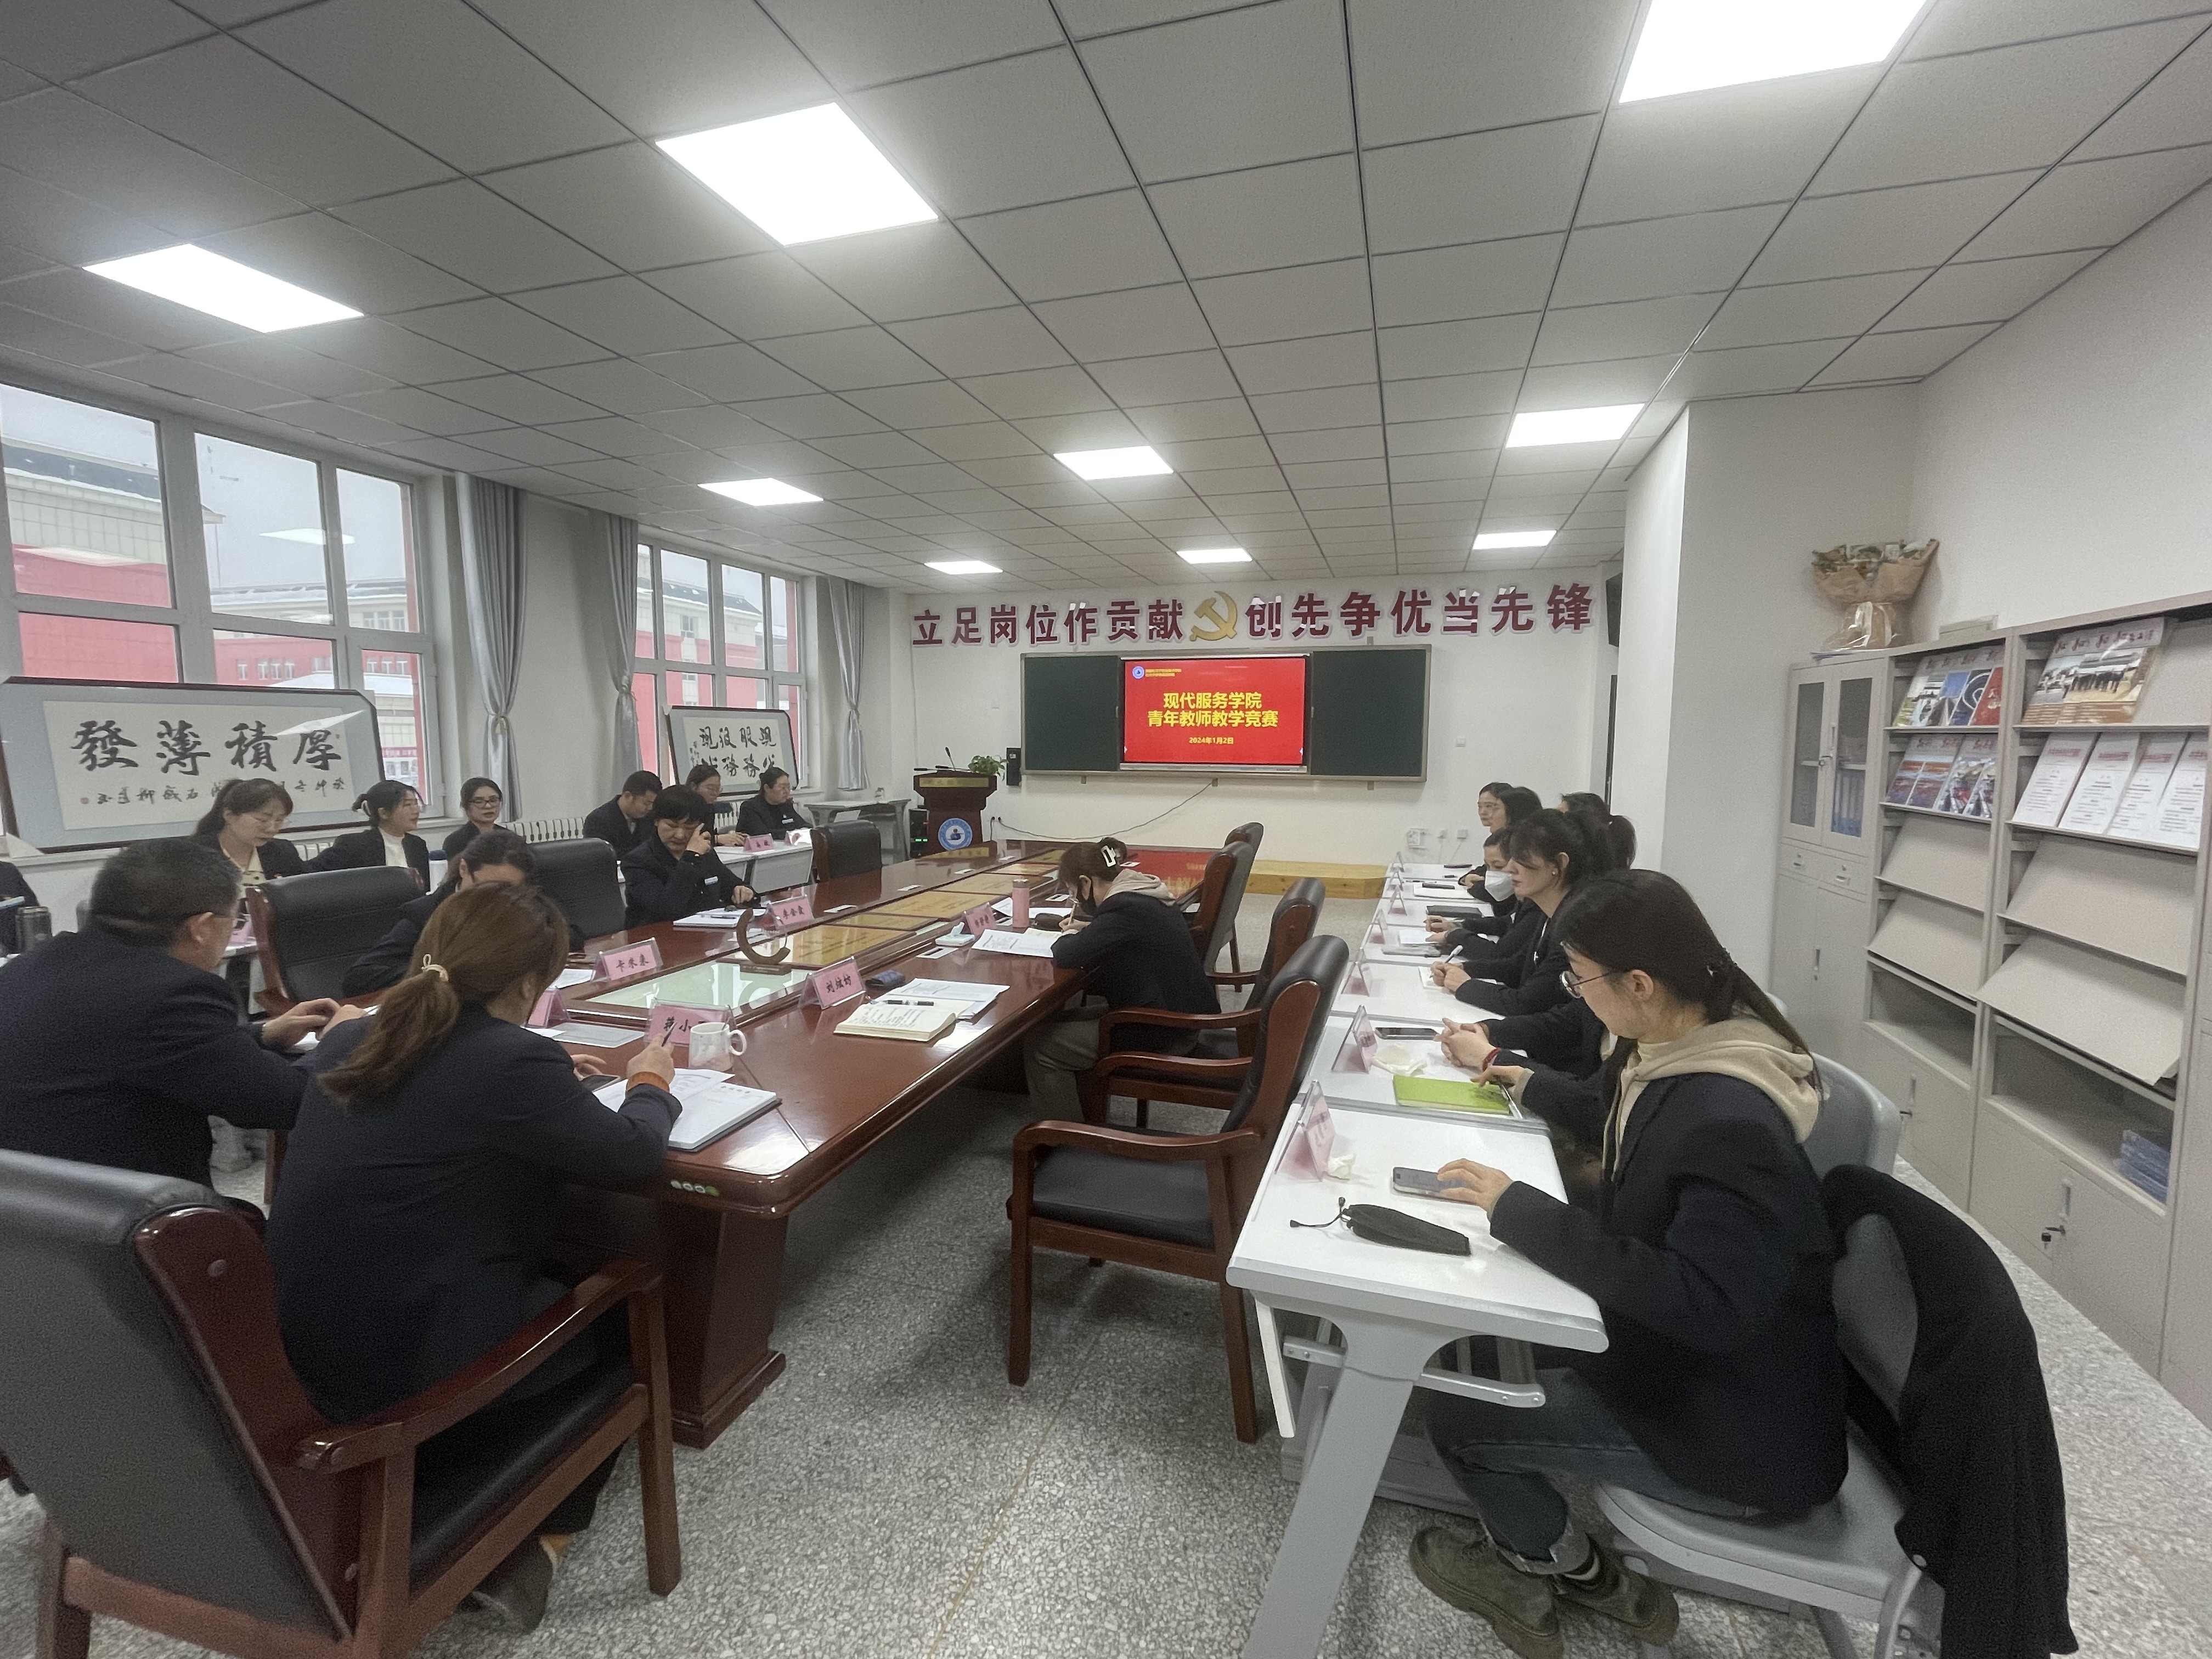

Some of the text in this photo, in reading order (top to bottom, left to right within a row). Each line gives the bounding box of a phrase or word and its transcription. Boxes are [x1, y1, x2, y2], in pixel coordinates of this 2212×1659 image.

[912, 583, 1592, 645] 立足岗位作贡献 创先争优当先锋
[1163, 692, 1262, 709] 现代服务学院
[1148, 710, 1278, 727] 青年教师教学竞赛
